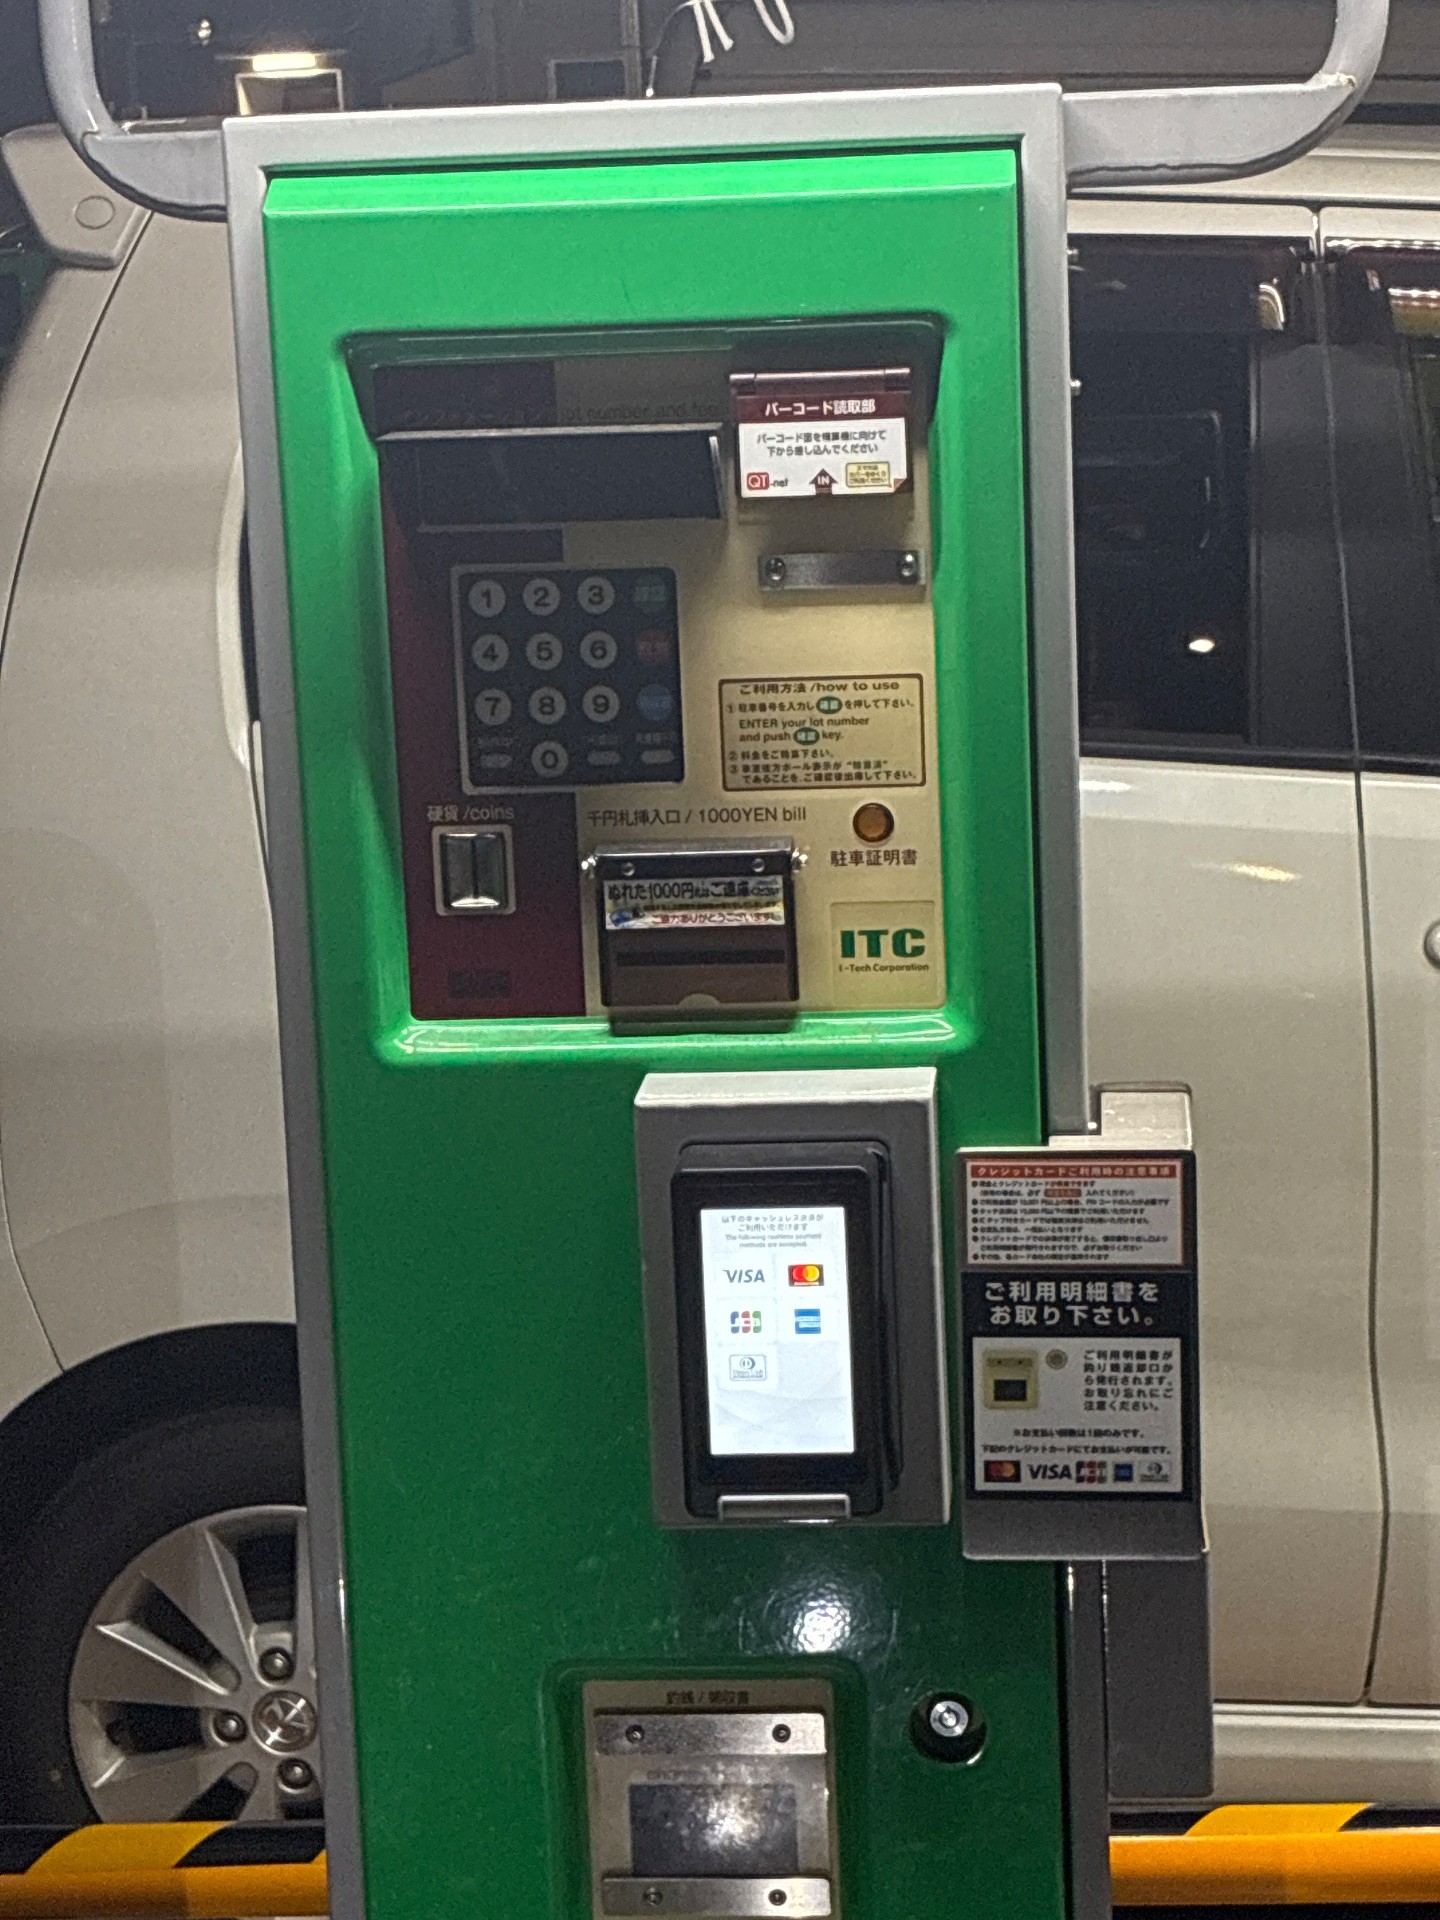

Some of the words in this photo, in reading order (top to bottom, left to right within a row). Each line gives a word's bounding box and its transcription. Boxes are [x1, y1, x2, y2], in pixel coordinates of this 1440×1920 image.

[765, 398, 876, 416] バーコード読取部
[817, 475, 830, 485] IN
[481, 587, 492, 608] 1
[533, 586, 550, 607] 2
[588, 585, 604, 605] 3
[481, 642, 498, 662] 4
[536, 641, 553, 661] 5
[590, 640, 607, 660] 6
[740, 683, 806, 695] ご利用方法
[853, 682, 868, 691] to
[872, 682, 899, 690] use
[484, 696, 501, 716] 7
[539, 695, 555, 715] 8
[593, 694, 609, 714] 9
[739, 718, 778, 729] ENTER
[782, 718, 806, 729] your
[809, 717, 824, 727] lot
[827, 716, 870, 727] number
[739, 732, 760, 742] and
[763, 732, 791, 743] push
[540, 748, 558, 769] 0
[587, 809, 681, 828] 千円札挿入口
[699, 807, 777, 824] 1000YEN
[782, 807, 807, 822] bill
[830, 849, 917, 867] 駐車証明書
[839, 928, 926, 958] ITC
[723, 1269, 765, 1283] VISA
[985, 1280, 1159, 1302] ご利用明細書を
[990, 1304, 1154, 1326] お取り下さい。
[1027, 1464, 1073, 1479] VISA
